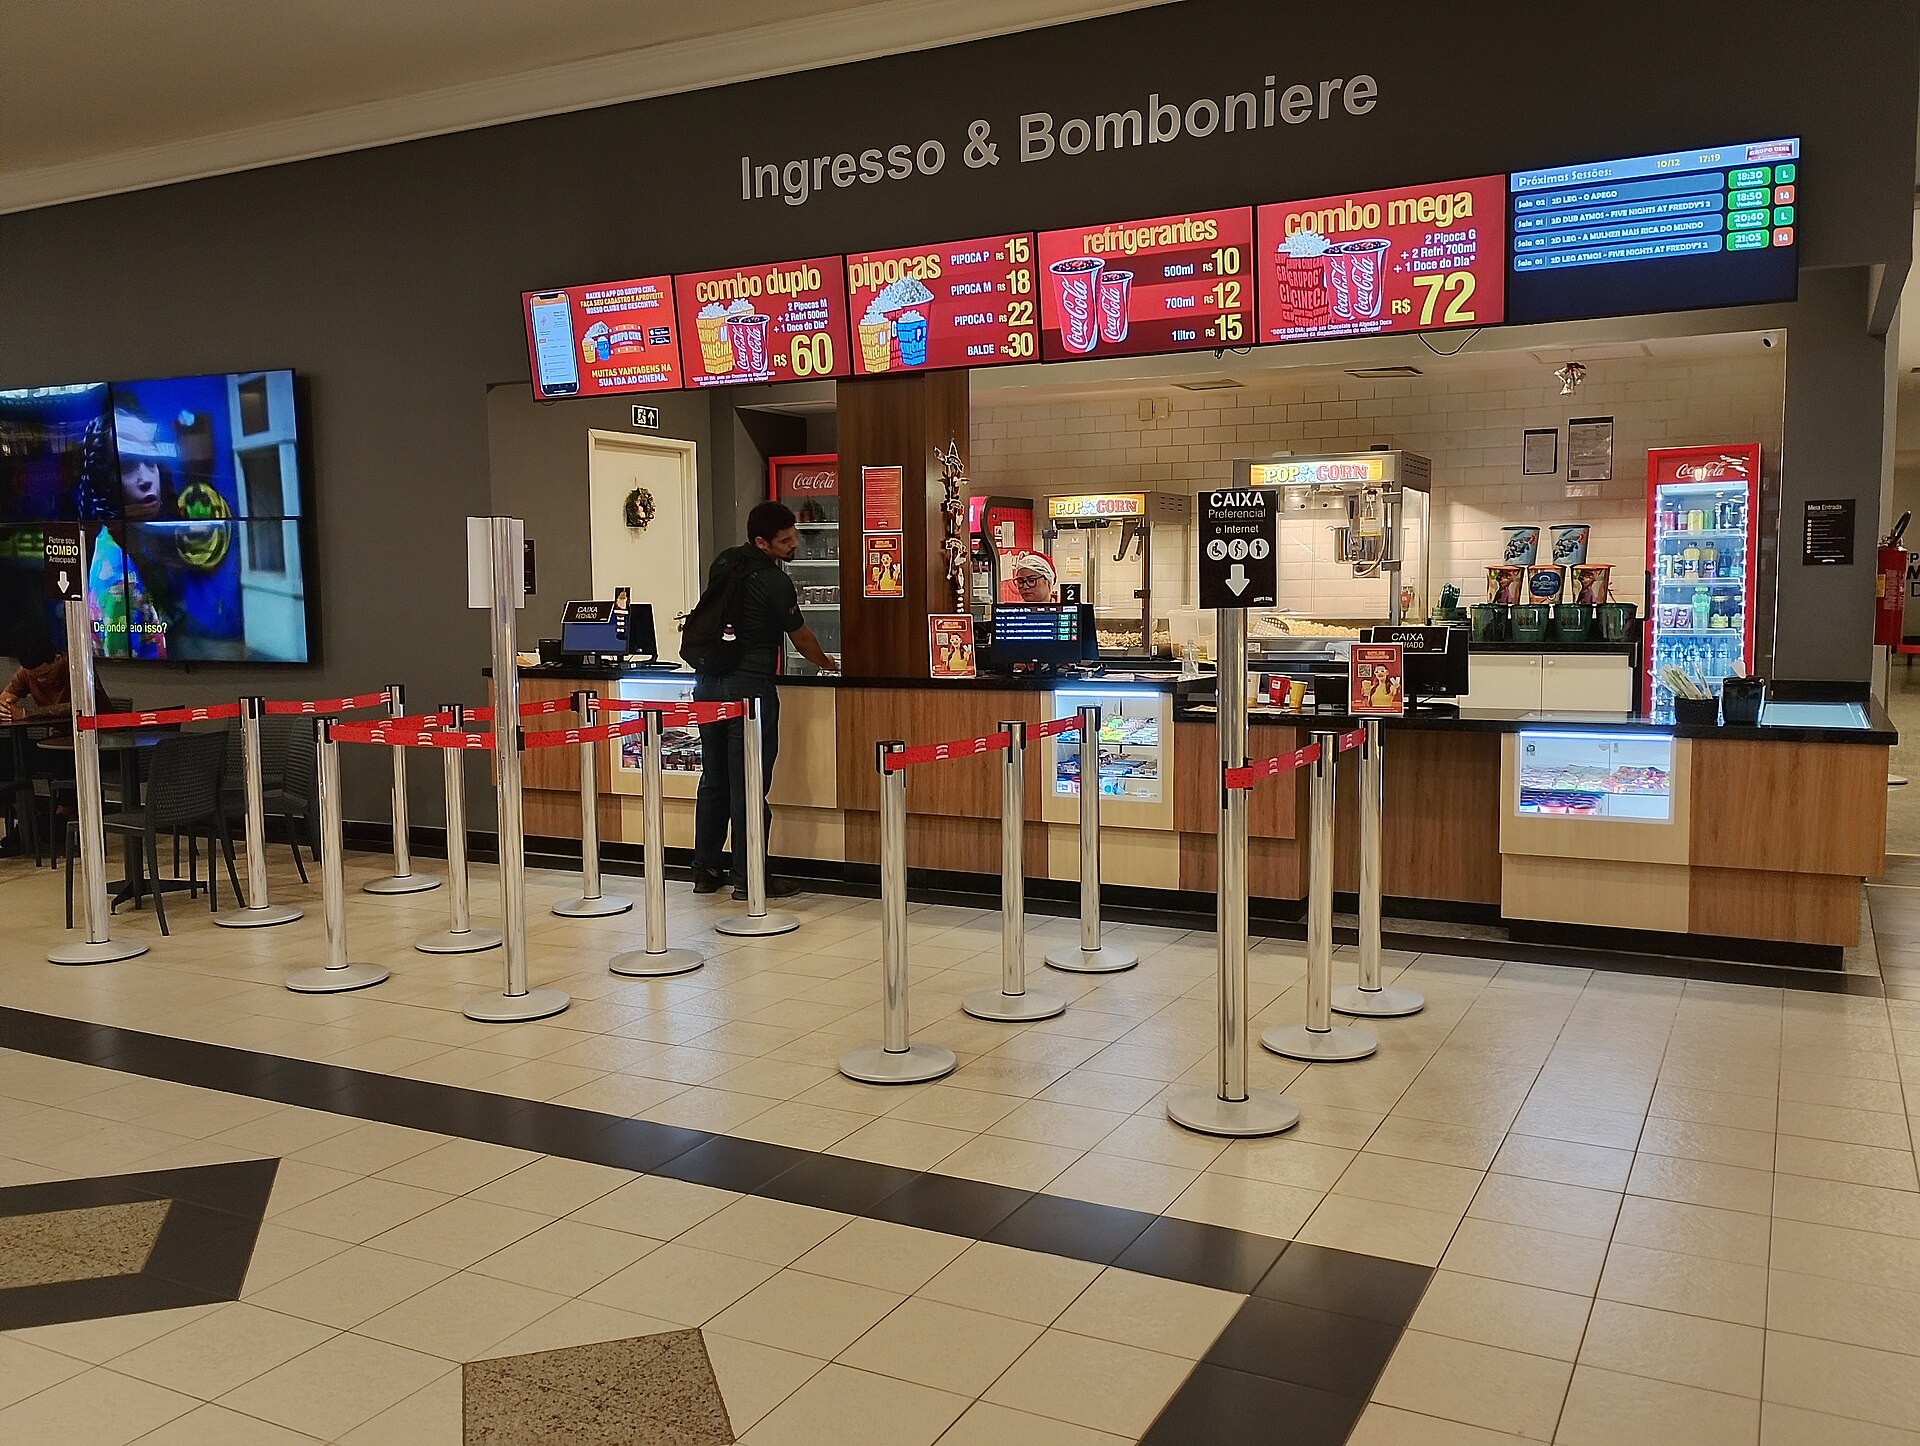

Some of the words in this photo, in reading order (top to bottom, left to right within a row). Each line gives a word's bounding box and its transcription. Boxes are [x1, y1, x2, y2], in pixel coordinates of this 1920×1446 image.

[741, 140, 945, 205] Ingresso
[963, 120, 999, 168] &
[1019, 74, 1379, 162] Bomboniere
[1657, 159, 1680, 167] 10/12
[1699, 154, 1720, 163] 17:19
[1519, 173, 1568, 186] Próximas
[1572, 169, 1612, 180] Sessões:
[1737, 171, 1763, 180] 18:30
[1591, 191, 1617, 200] APEGO
[1737, 192, 1762, 201] 18:50
[1285, 200, 1380, 238] combo
[1388, 192, 1472, 227] mega
[1734, 212, 1764, 222] 20:40
[1083, 218, 1217, 254] refrigerantes
[1425, 235, 1431, 244] 2
[1434, 231, 1467, 245] Pipoca
[1469, 229, 1476, 239] G
[1735, 233, 1761, 243] 21:05
[951, 253, 981, 265] PIPOCA
[983, 252, 989, 262] P
[996, 252, 1004, 260] R$
[1005, 238, 1029, 264] 15
[1412, 249, 1418, 258] 2
[1421, 246, 1444, 258] Refri
[1447, 242, 1475, 256] 700ml
[1164, 264, 1193, 277] 500ml
[1203, 263, 1213, 272] R$
[1211, 247, 1240, 275] 10
[1406, 262, 1410, 272] 1
[1414, 260, 1437, 271] Doce
[1439, 258, 1451, 269] do
[849, 254, 941, 294] pipocas
[696, 272, 762, 302] combo
[766, 264, 820, 298] duplo
[951, 284, 981, 296] PIPOCA
[983, 282, 992, 292] M
[997, 283, 1006, 291] R$
[1006, 269, 1030, 295] 18
[1166, 296, 1194, 309] 700ml
[1204, 295, 1213, 304] R$
[1212, 281, 1241, 309] 12
[1392, 299, 1411, 315] R$
[1413, 271, 1475, 326] 72
[788, 303, 792, 311] 2
[794, 301, 819, 312] Pipocas
[954, 315, 984, 326] PIPOCA
[987, 313, 992, 323] G
[999, 315, 1007, 323] R$
[1008, 301, 1033, 327] 22
[1205, 329, 1215, 338] R$
[1214, 314, 1242, 341] 15
[967, 344, 994, 356] BALDE
[1001, 346, 1009, 354] R$
[1008, 332, 1033, 358] 30
[774, 355, 786, 366] R$
[791, 333, 833, 376] 60
[592, 369, 617, 378] MUITAS
[619, 364, 660, 375] VANTAGENS
[661, 364, 671, 372] NA
[599, 377, 613, 386] SUA
[615, 377, 626, 385] IDA
[627, 375, 637, 384] AO
[638, 373, 668, 383] CINEMA.
[1265, 466, 1299, 483] POP
[1318, 464, 1369, 480] CORN
[1055, 501, 1083, 515] POP
[1096, 499, 1138, 513] CORN
[1210, 492, 1264, 507] CAIXA
[1208, 508, 1266, 519] Preferencial
[1224, 524, 1259, 534] Internet
[46, 545, 78, 555] COMBO
[1067, 590, 1074, 600] 2
[94, 622, 104, 632] De
[107, 622, 125, 633] onde
[145, 622, 167, 634] isso?
[1392, 633, 1424, 641] CAIXA
